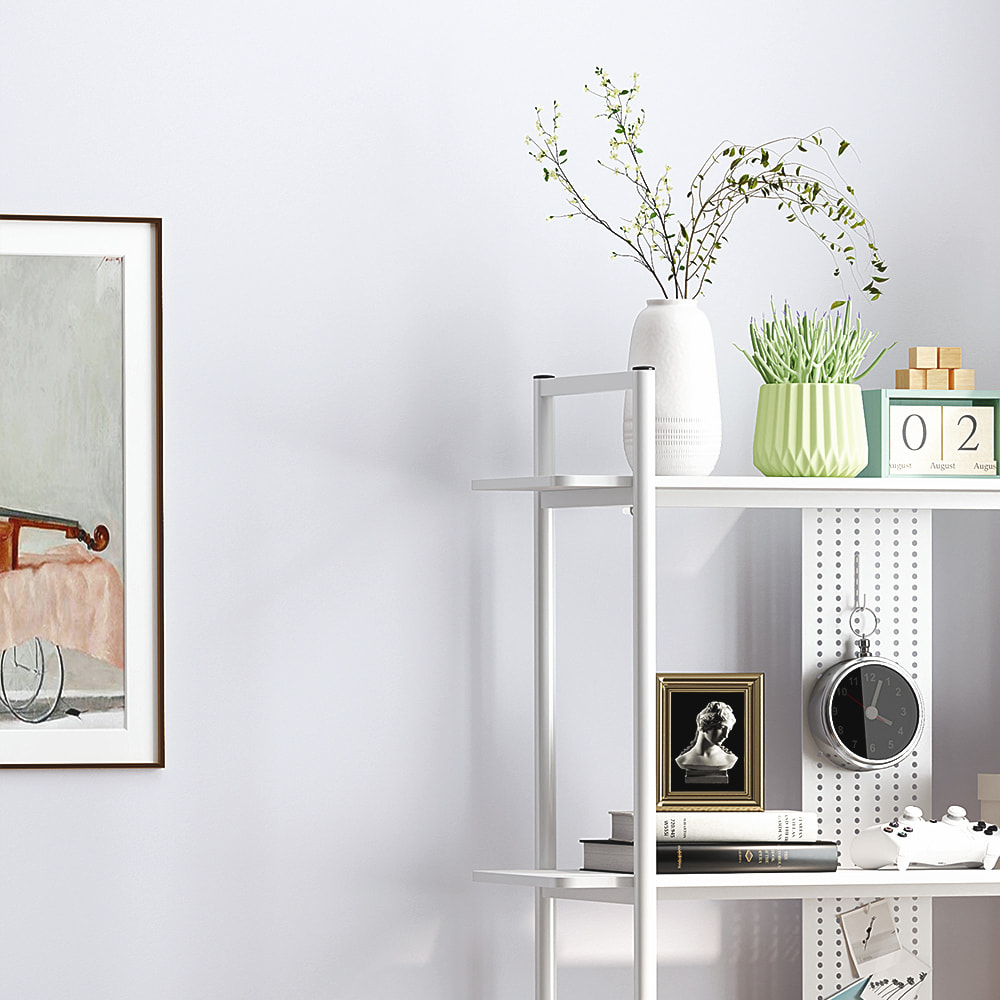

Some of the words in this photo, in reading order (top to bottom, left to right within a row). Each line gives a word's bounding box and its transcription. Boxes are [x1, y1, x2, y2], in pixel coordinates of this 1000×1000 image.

[957, 414, 980, 451] 2
[930, 462, 956, 471] August
[974, 462, 997, 472] Augus
[849, 677, 858, 686] 11
[864, 673, 876, 683] 12
[895, 688, 902, 697] 2
[900, 707, 907, 716] 3
[898, 727, 904, 735] 4
[851, 740, 858, 749] 7
[869, 743, 876, 752] 6
[888, 740, 894, 749] 5
